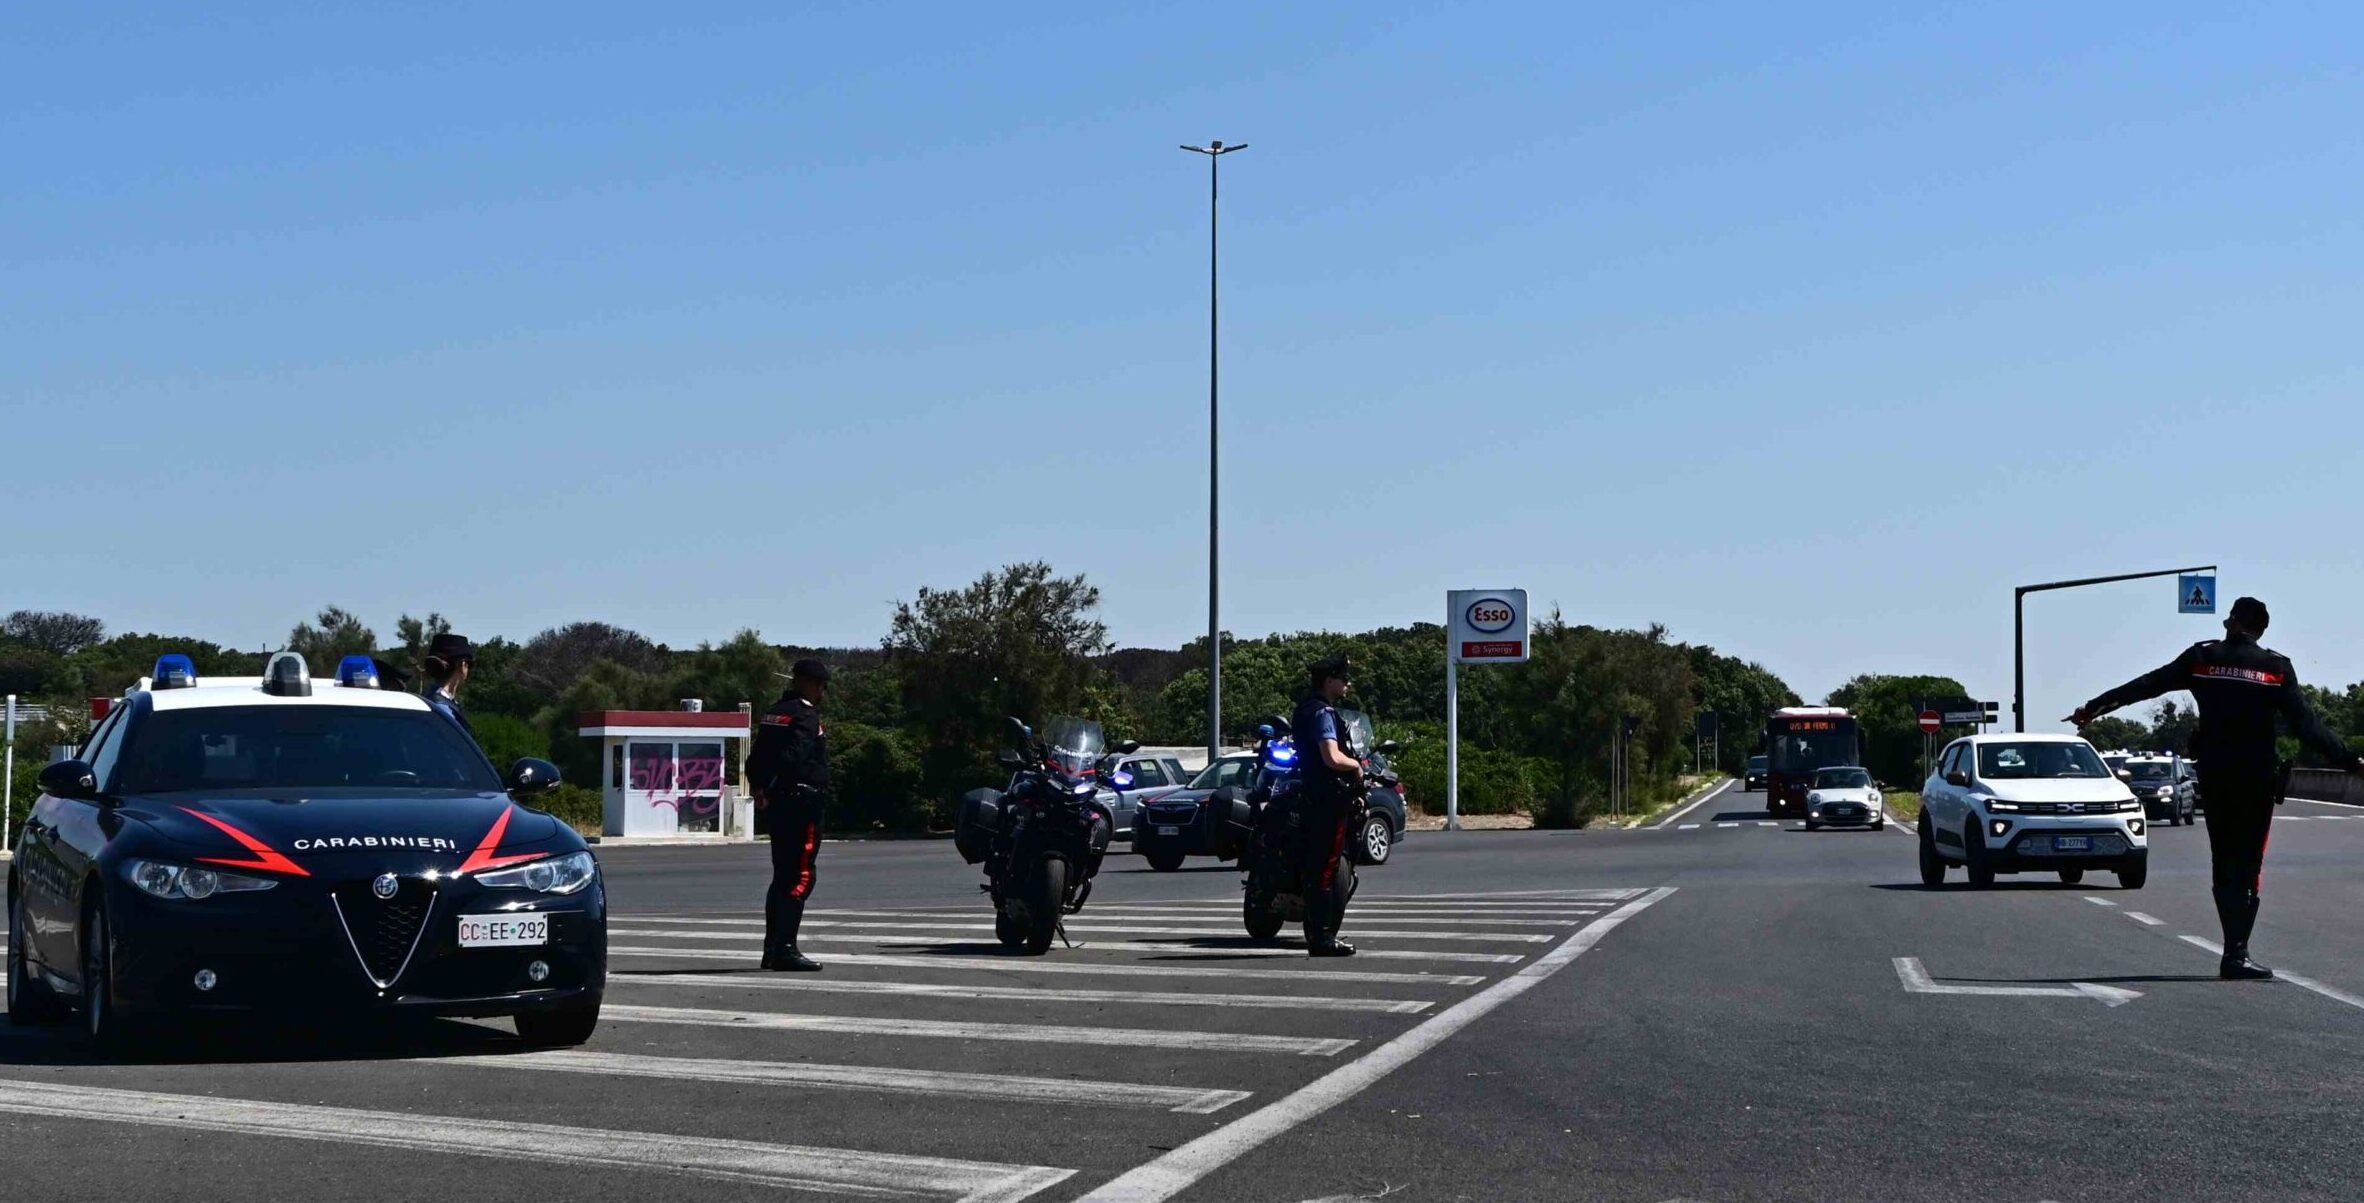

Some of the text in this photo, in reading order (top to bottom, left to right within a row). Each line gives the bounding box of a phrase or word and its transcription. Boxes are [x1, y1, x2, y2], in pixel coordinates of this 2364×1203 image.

[1474, 607, 1509, 621] Esso
[1483, 646, 1513, 655] Synergy
[2208, 665, 2265, 681] CARABINIERI
[294, 836, 456, 850] CARABINIERI
